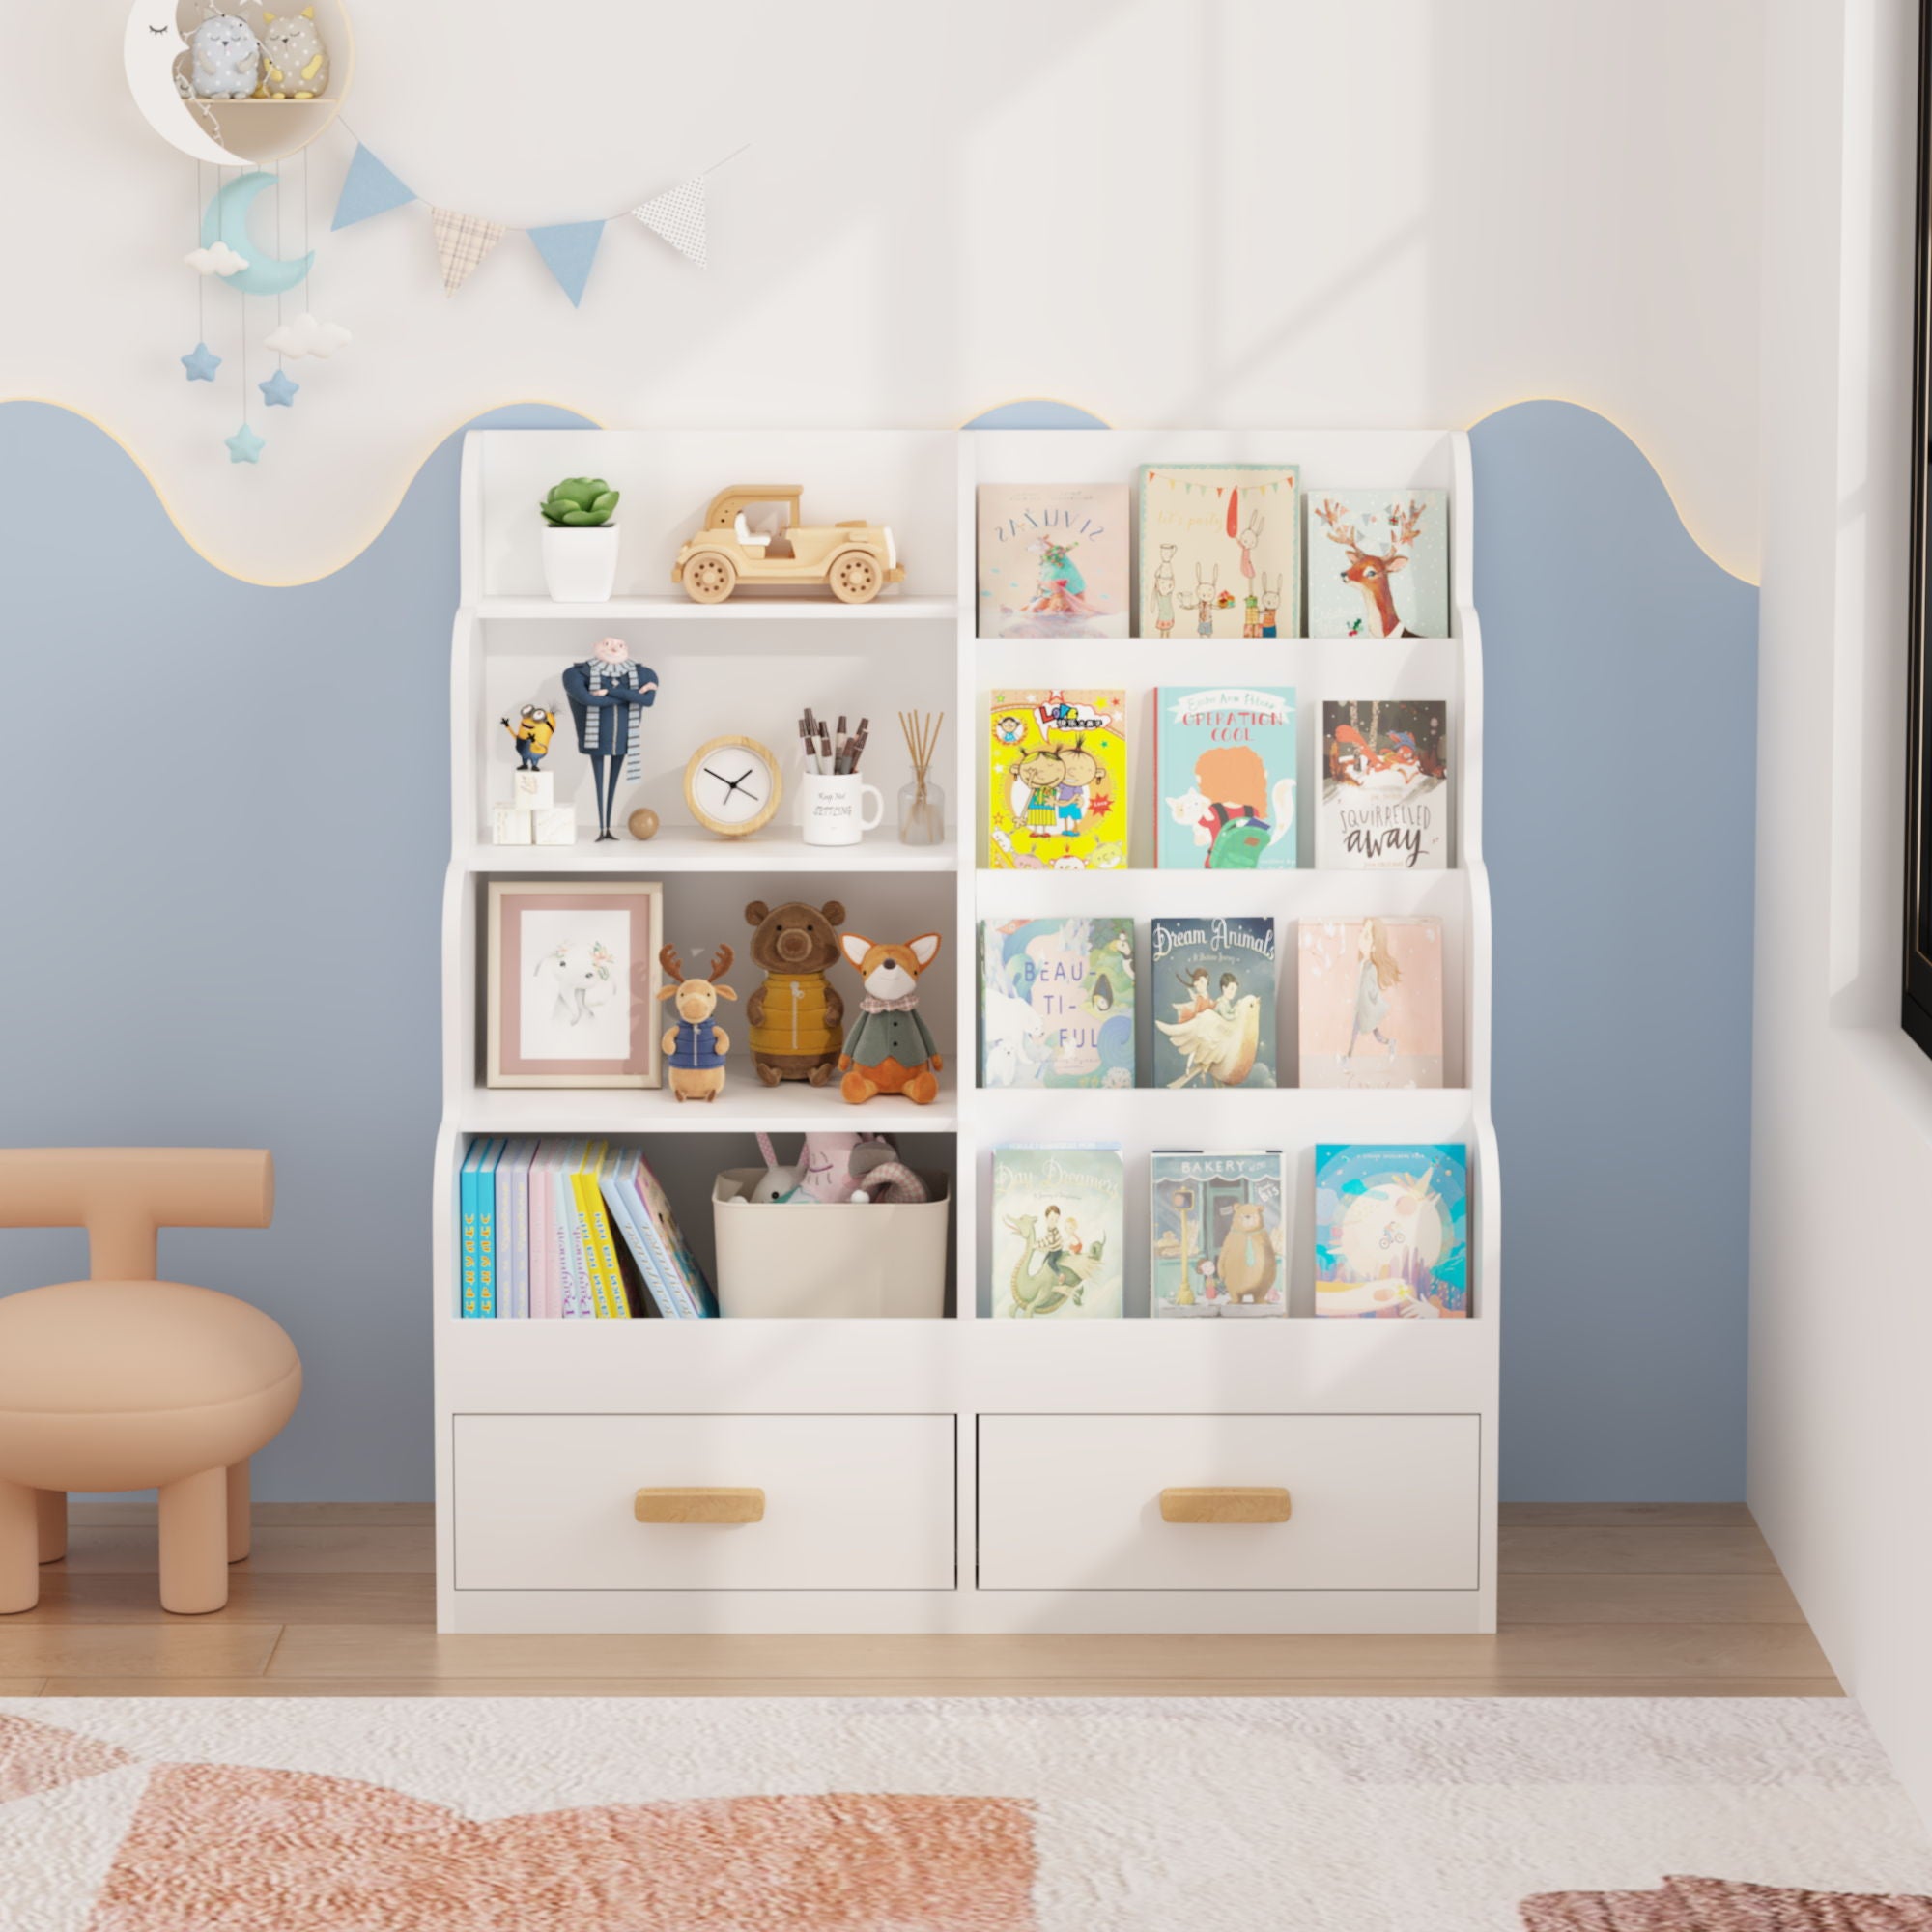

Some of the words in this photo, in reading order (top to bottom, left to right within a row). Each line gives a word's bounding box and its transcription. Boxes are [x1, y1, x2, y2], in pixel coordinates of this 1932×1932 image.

[1182, 712, 1283, 725] OPERATION
[1210, 727, 1256, 742] COOL
[1339, 804, 1431, 834] SQUIRRELLED
[1343, 828, 1430, 867] away
[1152, 923, 1207, 962] Dream
[1210, 918, 1275, 961] Animals
[1181, 1159, 1246, 1174] BAKERY
